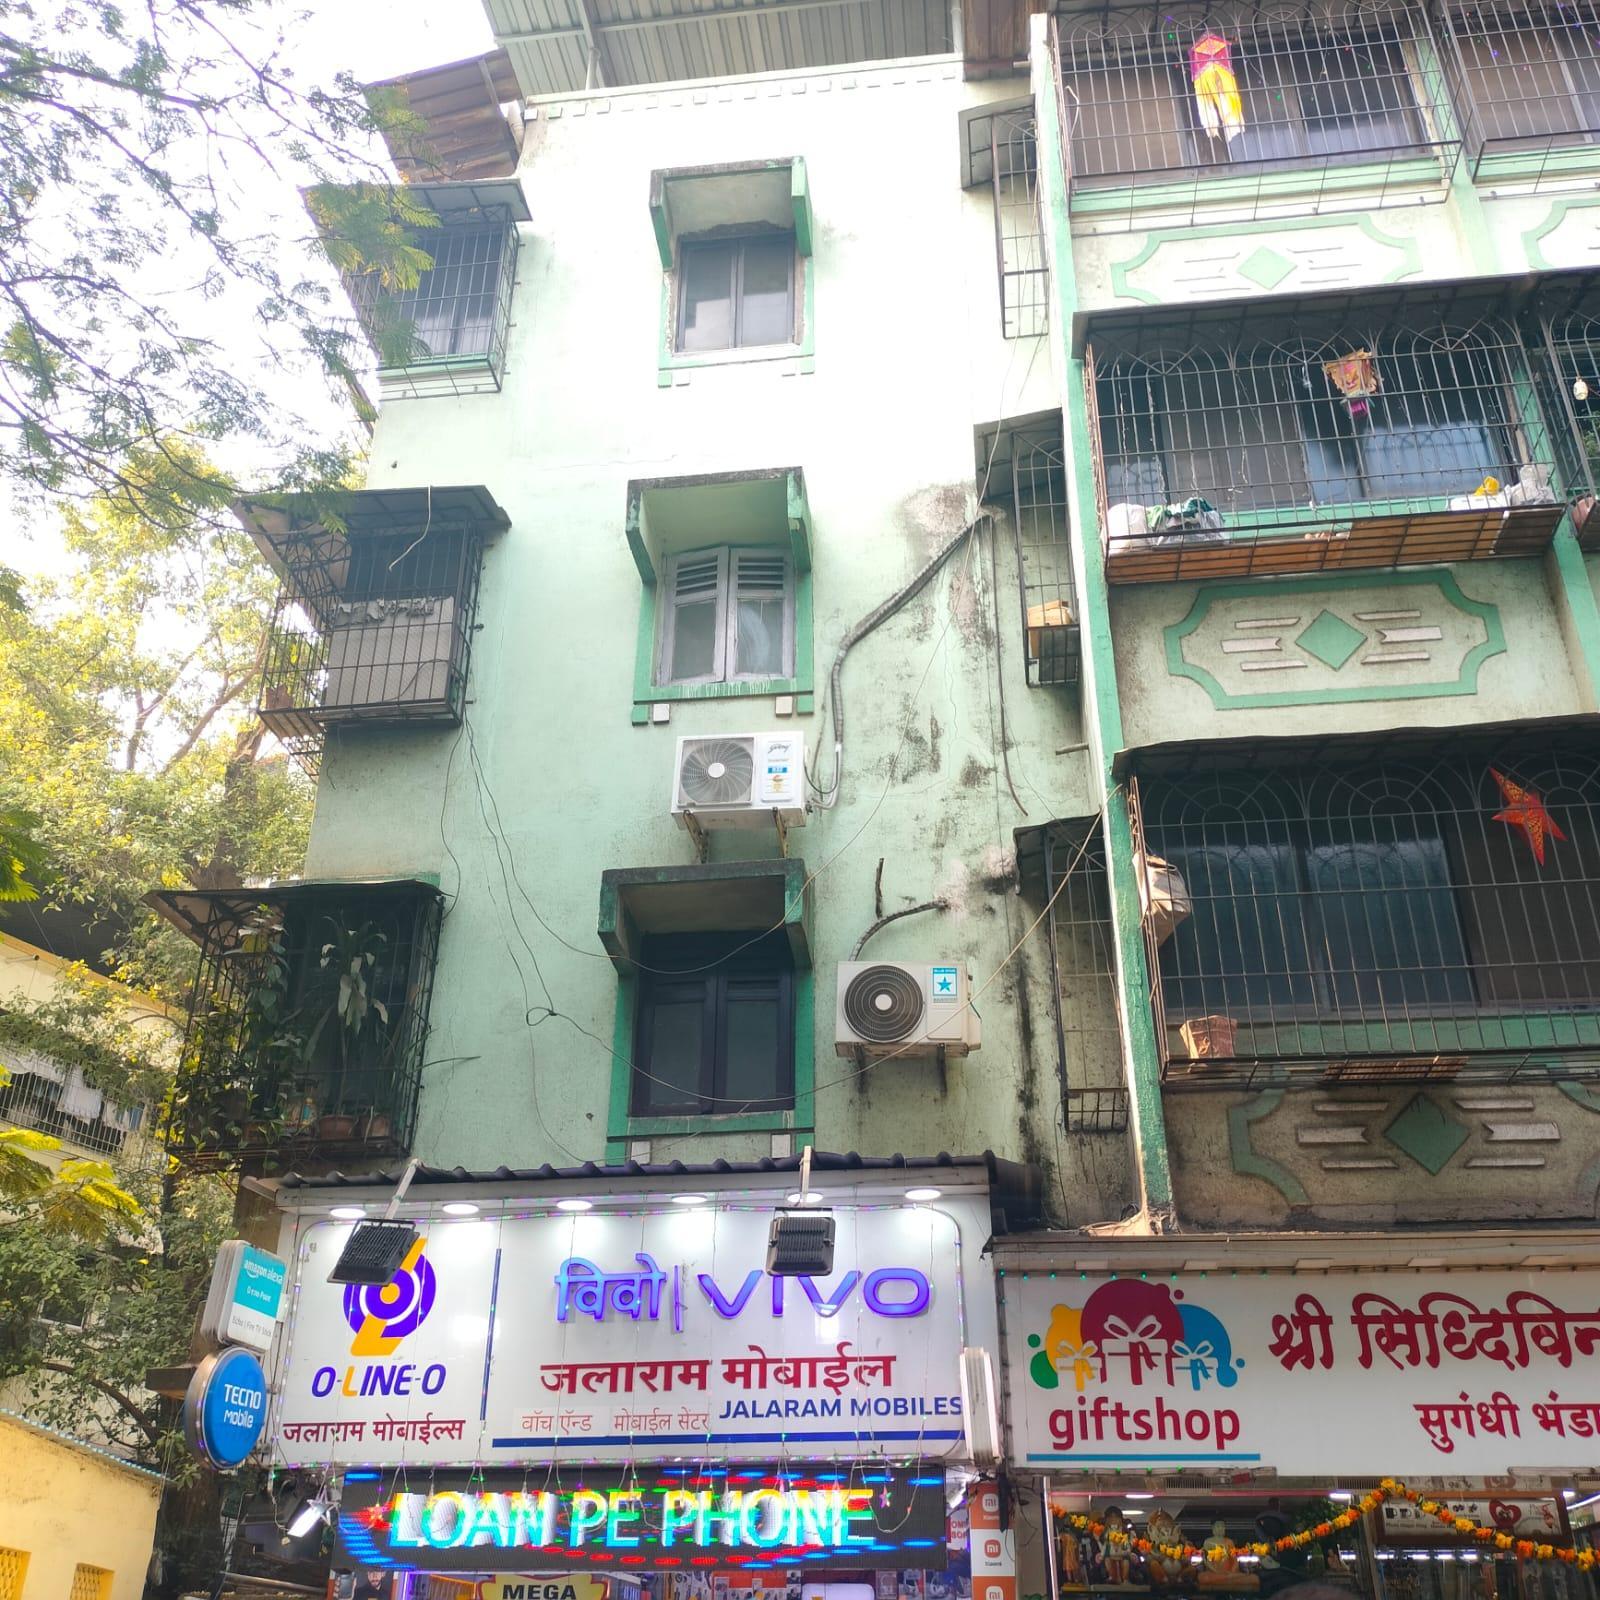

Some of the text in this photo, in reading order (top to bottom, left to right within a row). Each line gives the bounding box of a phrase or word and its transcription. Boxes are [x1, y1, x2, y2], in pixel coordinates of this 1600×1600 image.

[244, 1260, 267, 1278] amazon
[554, 1252, 667, 1322] विवो
[1268, 1293, 1333, 1371] श्री
[540, 1341, 896, 1396] जलाराम मोबाईल
[224, 1384, 262, 1410] TECNO
[719, 1396, 961, 1419] JALARAM MOBILES
[283, 1412, 466, 1445] जलाराम मोबाईल्स
[521, 1410, 554, 1433] वॉच
[614, 1407, 673, 1434] मोबाईल
[677, 1405, 711, 1432] सेंटर
[1048, 1395, 1241, 1451] giftshop
[1412, 1390, 1521, 1454] सुगंधी
[388, 1488, 876, 1549] LOAN PE PHONE
[502, 1584, 577, 1600] MEGA
